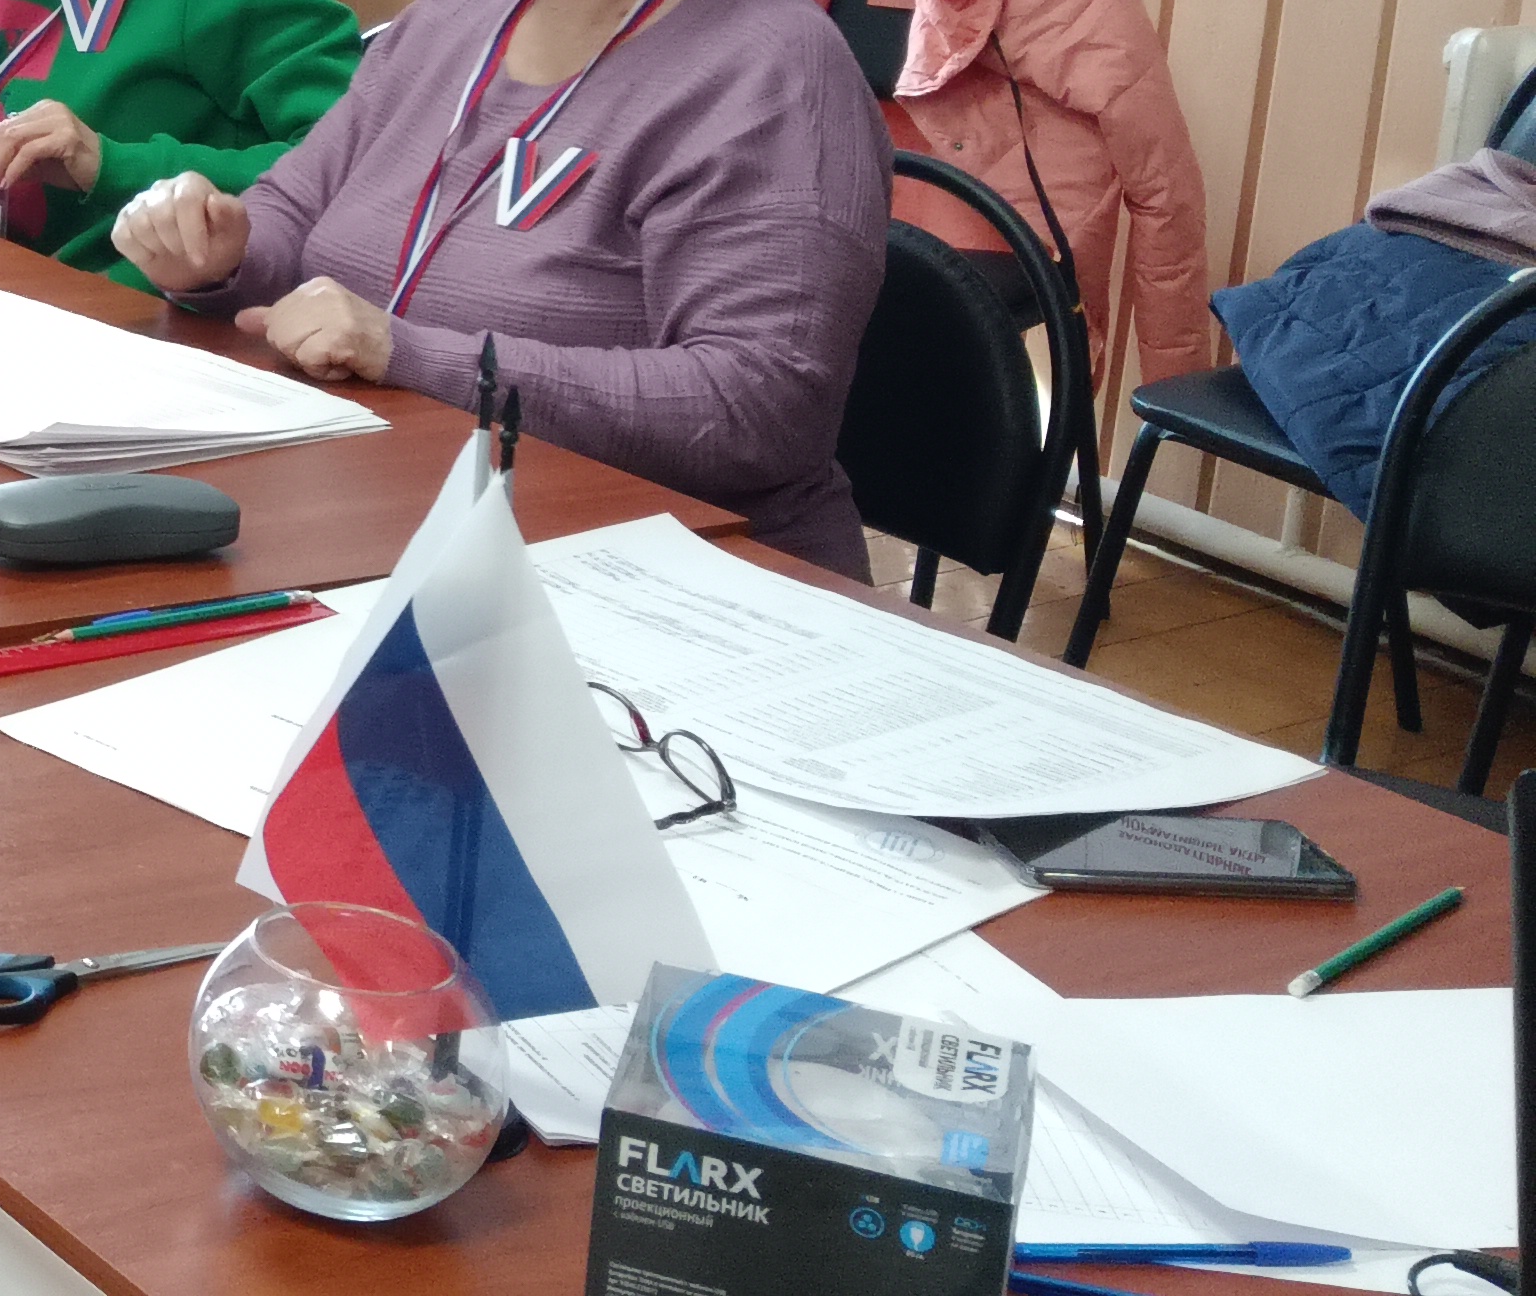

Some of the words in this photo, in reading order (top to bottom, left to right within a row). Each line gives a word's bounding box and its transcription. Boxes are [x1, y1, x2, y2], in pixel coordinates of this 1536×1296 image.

[618, 1135, 764, 1200] FLARX
[614, 1195, 714, 1228] проекционный
[616, 1173, 770, 1225] СВЕТИЛЬНИК
[657, 1219, 675, 1231] USB
